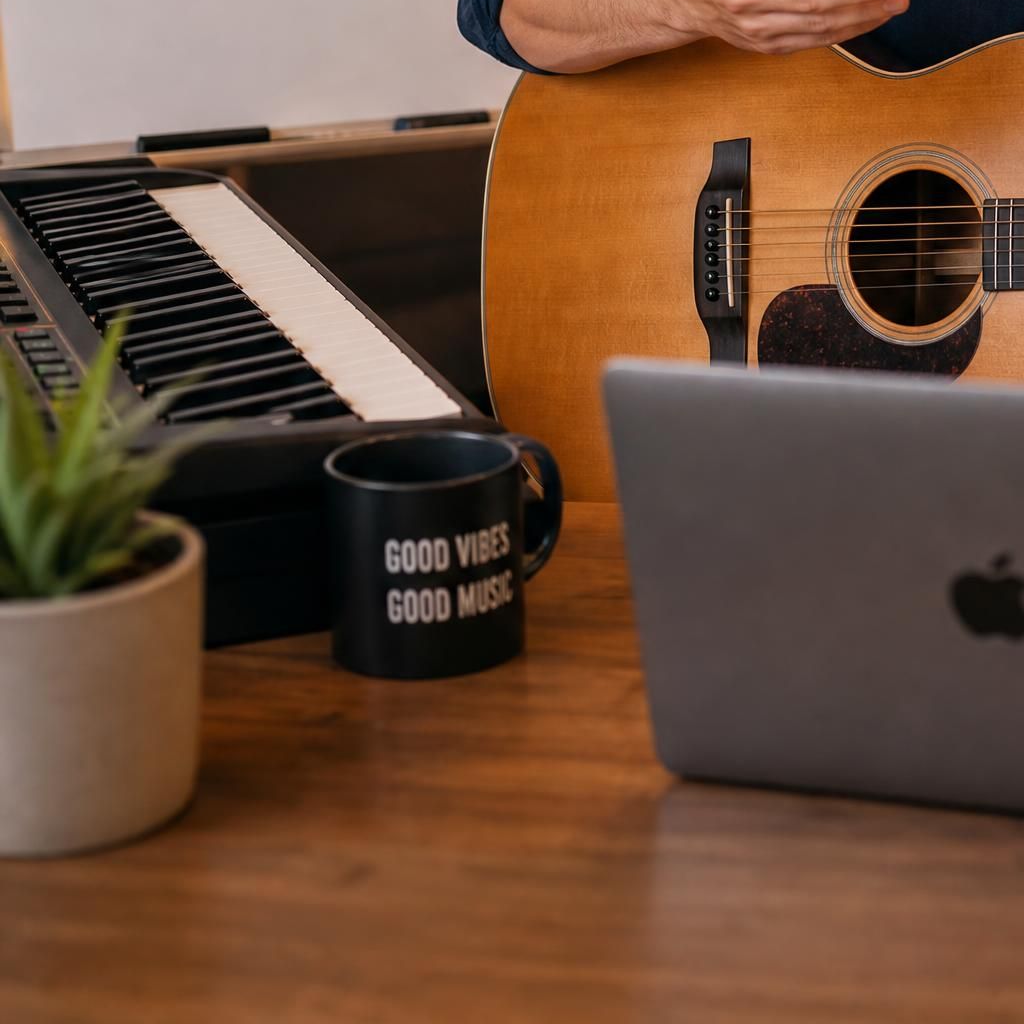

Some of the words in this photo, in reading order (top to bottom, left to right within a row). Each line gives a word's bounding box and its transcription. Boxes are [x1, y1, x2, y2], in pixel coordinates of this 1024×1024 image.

[384, 537, 450, 574] GOOD
[455, 521, 510, 568] VIBES
[386, 587, 451, 624] GOOD
[457, 569, 514, 619] MUSIC
